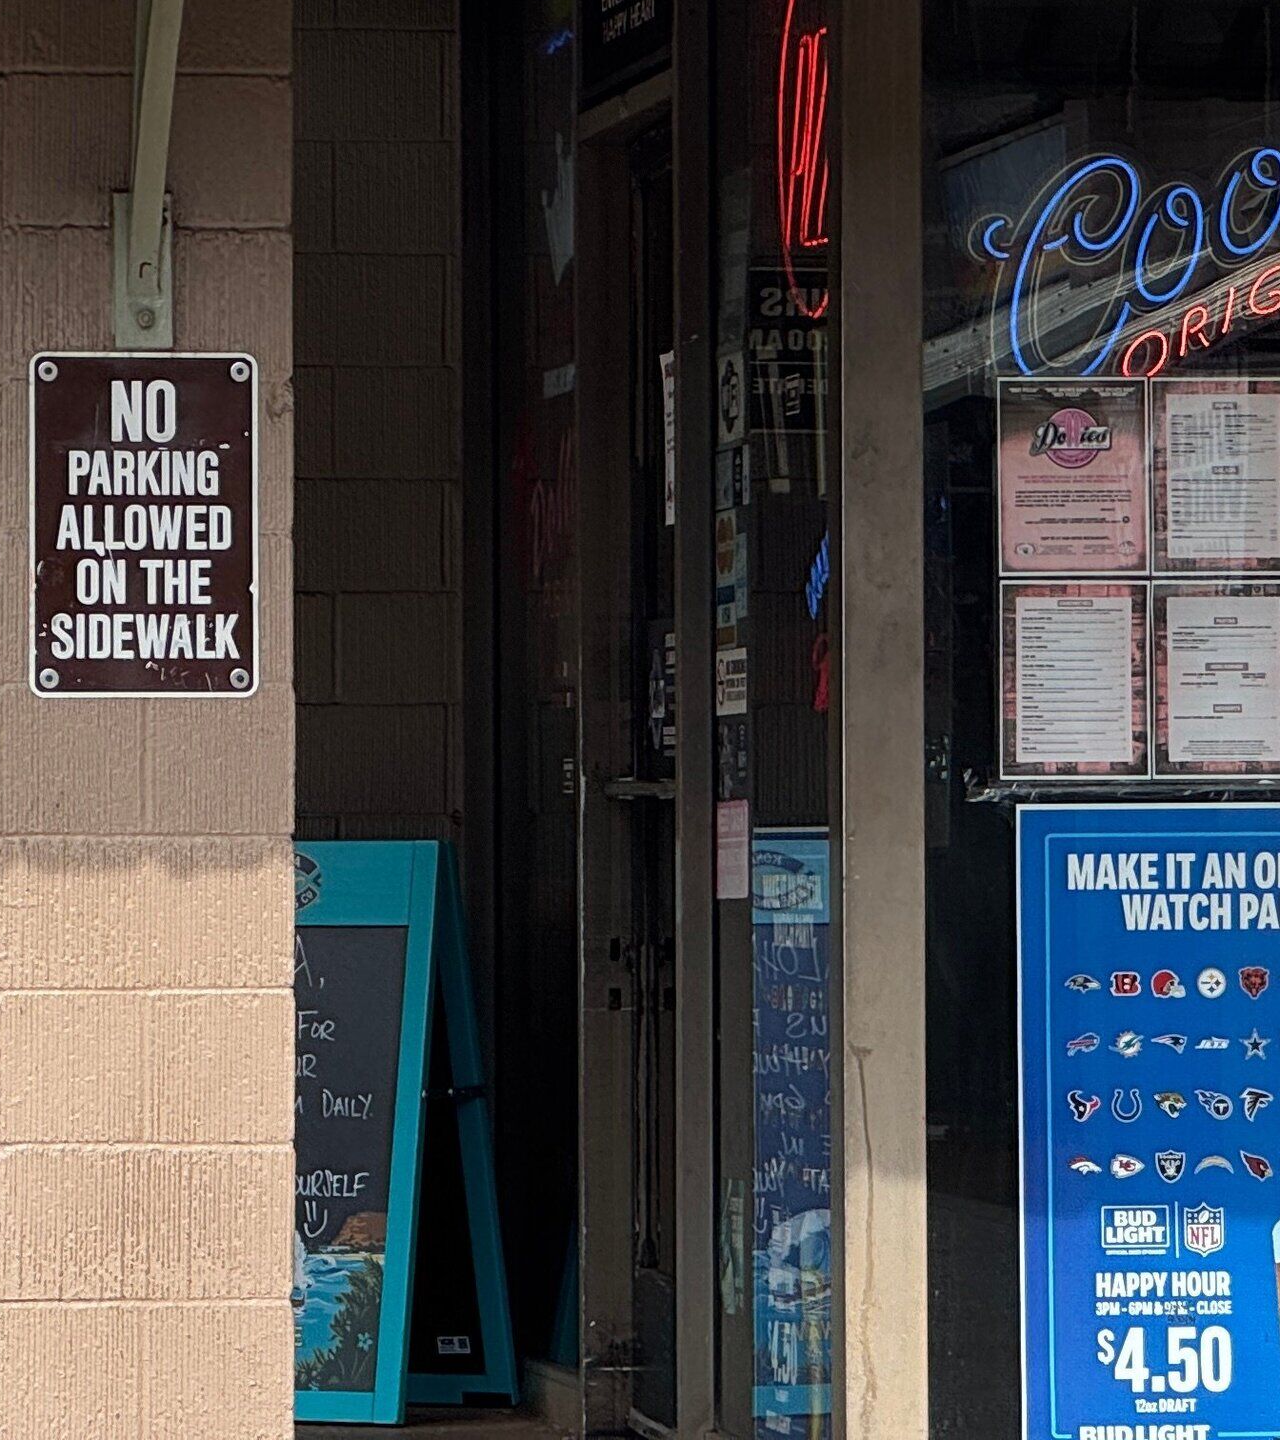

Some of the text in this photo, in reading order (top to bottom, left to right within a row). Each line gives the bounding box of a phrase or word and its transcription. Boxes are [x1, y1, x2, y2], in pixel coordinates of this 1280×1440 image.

[110, 379, 176, 444] NO
[67, 449, 220, 497] PARKING
[56, 503, 232, 552] ALLOWED
[75, 558, 213, 606] ON THE
[50, 612, 241, 661] SIDEWALK
[1067, 853, 1158, 891] MAKE
[1165, 852, 1196, 890] IT
[1201, 852, 1246, 890] AN
[1121, 892, 1231, 931] WATCH
[297, 1009, 336, 1042] FOR
[1106, 1226, 1166, 1244] LIGHT
[1113, 1210, 1157, 1227] BUD
[1189, 1226, 1219, 1248] NFL
[1095, 1271, 1232, 1298] HAPPY HOUR
[1095, 1301, 1121, 1316] 3PM
[1128, 1301, 1153, 1316] 6PM
[1153, 1301, 1163, 1315] &
[1196, 1300, 1233, 1315] CLOSE
[1096, 1325, 1232, 1393] $4.50
[1135, 1398, 1197, 1413] 12oz DRAFT
